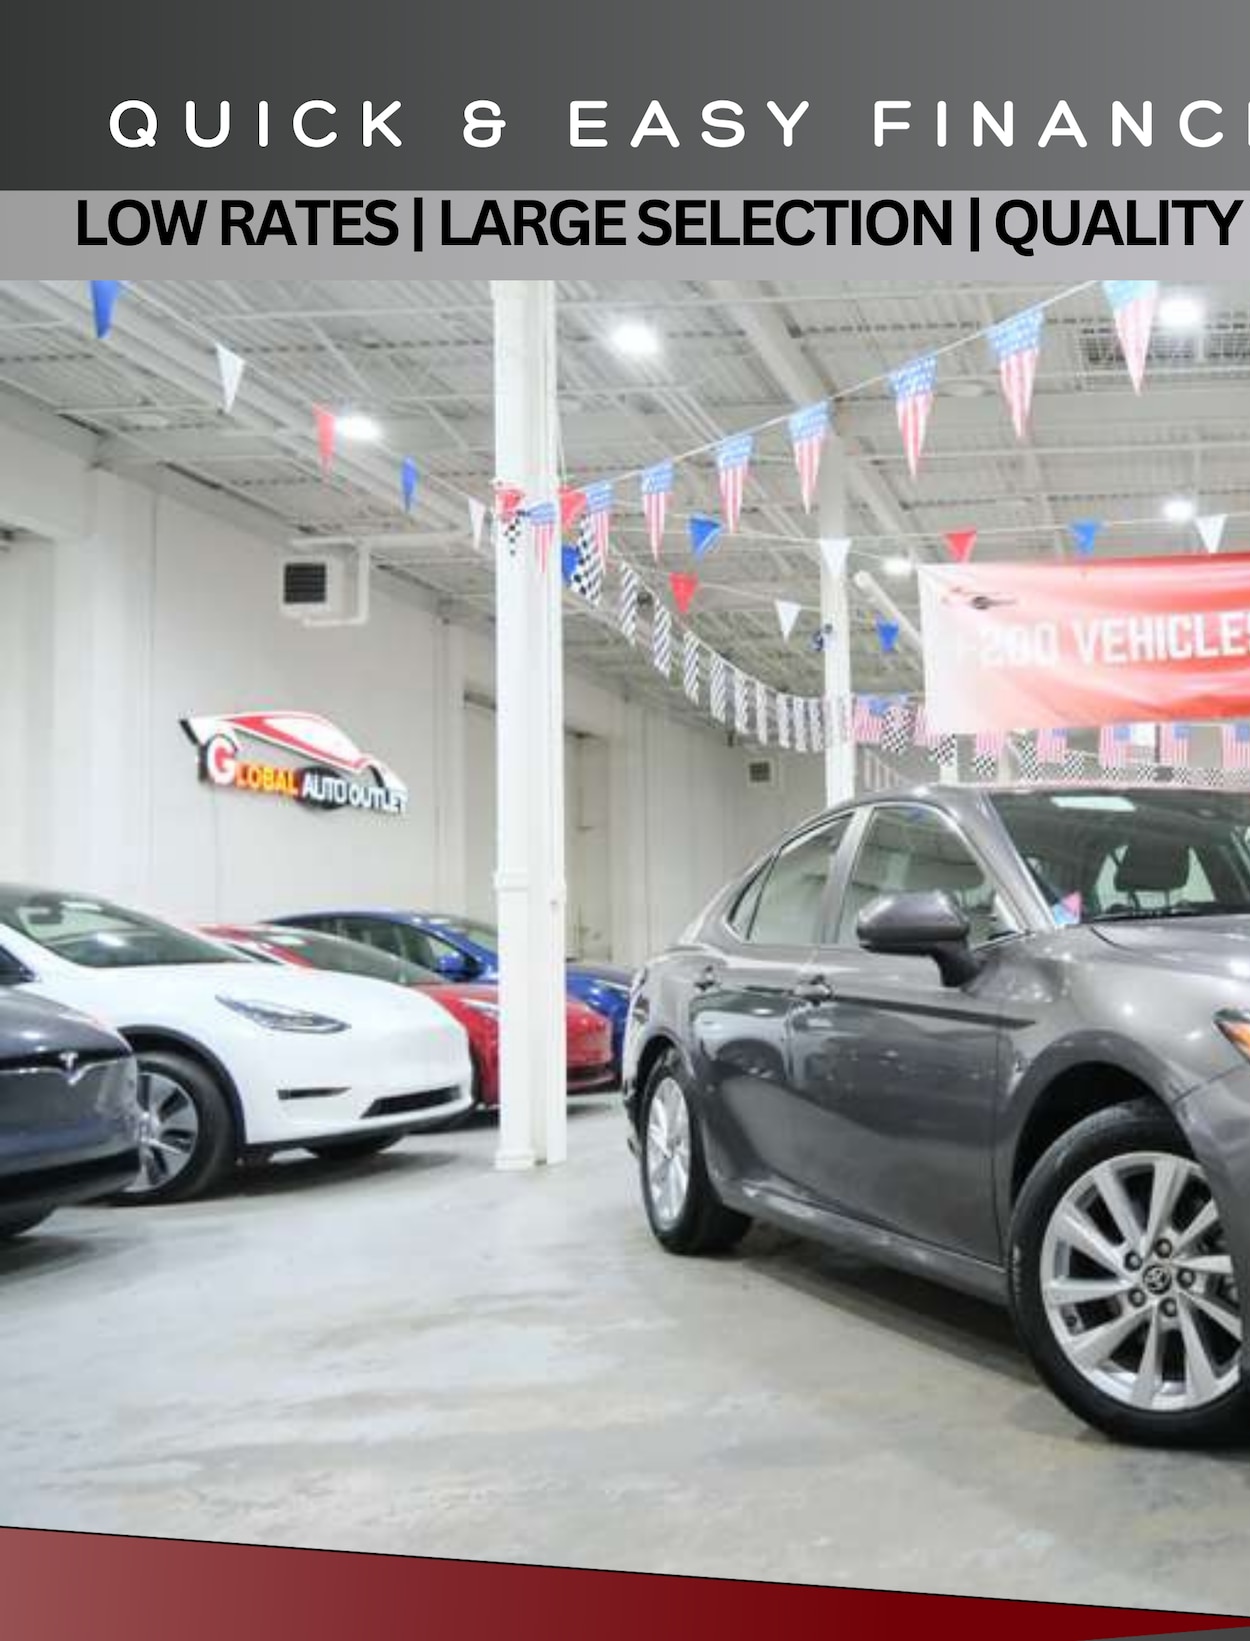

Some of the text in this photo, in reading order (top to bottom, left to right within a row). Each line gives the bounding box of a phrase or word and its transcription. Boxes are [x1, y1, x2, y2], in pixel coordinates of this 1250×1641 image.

[206, 733, 408, 813] GLOBAL AUTO OUTLET
